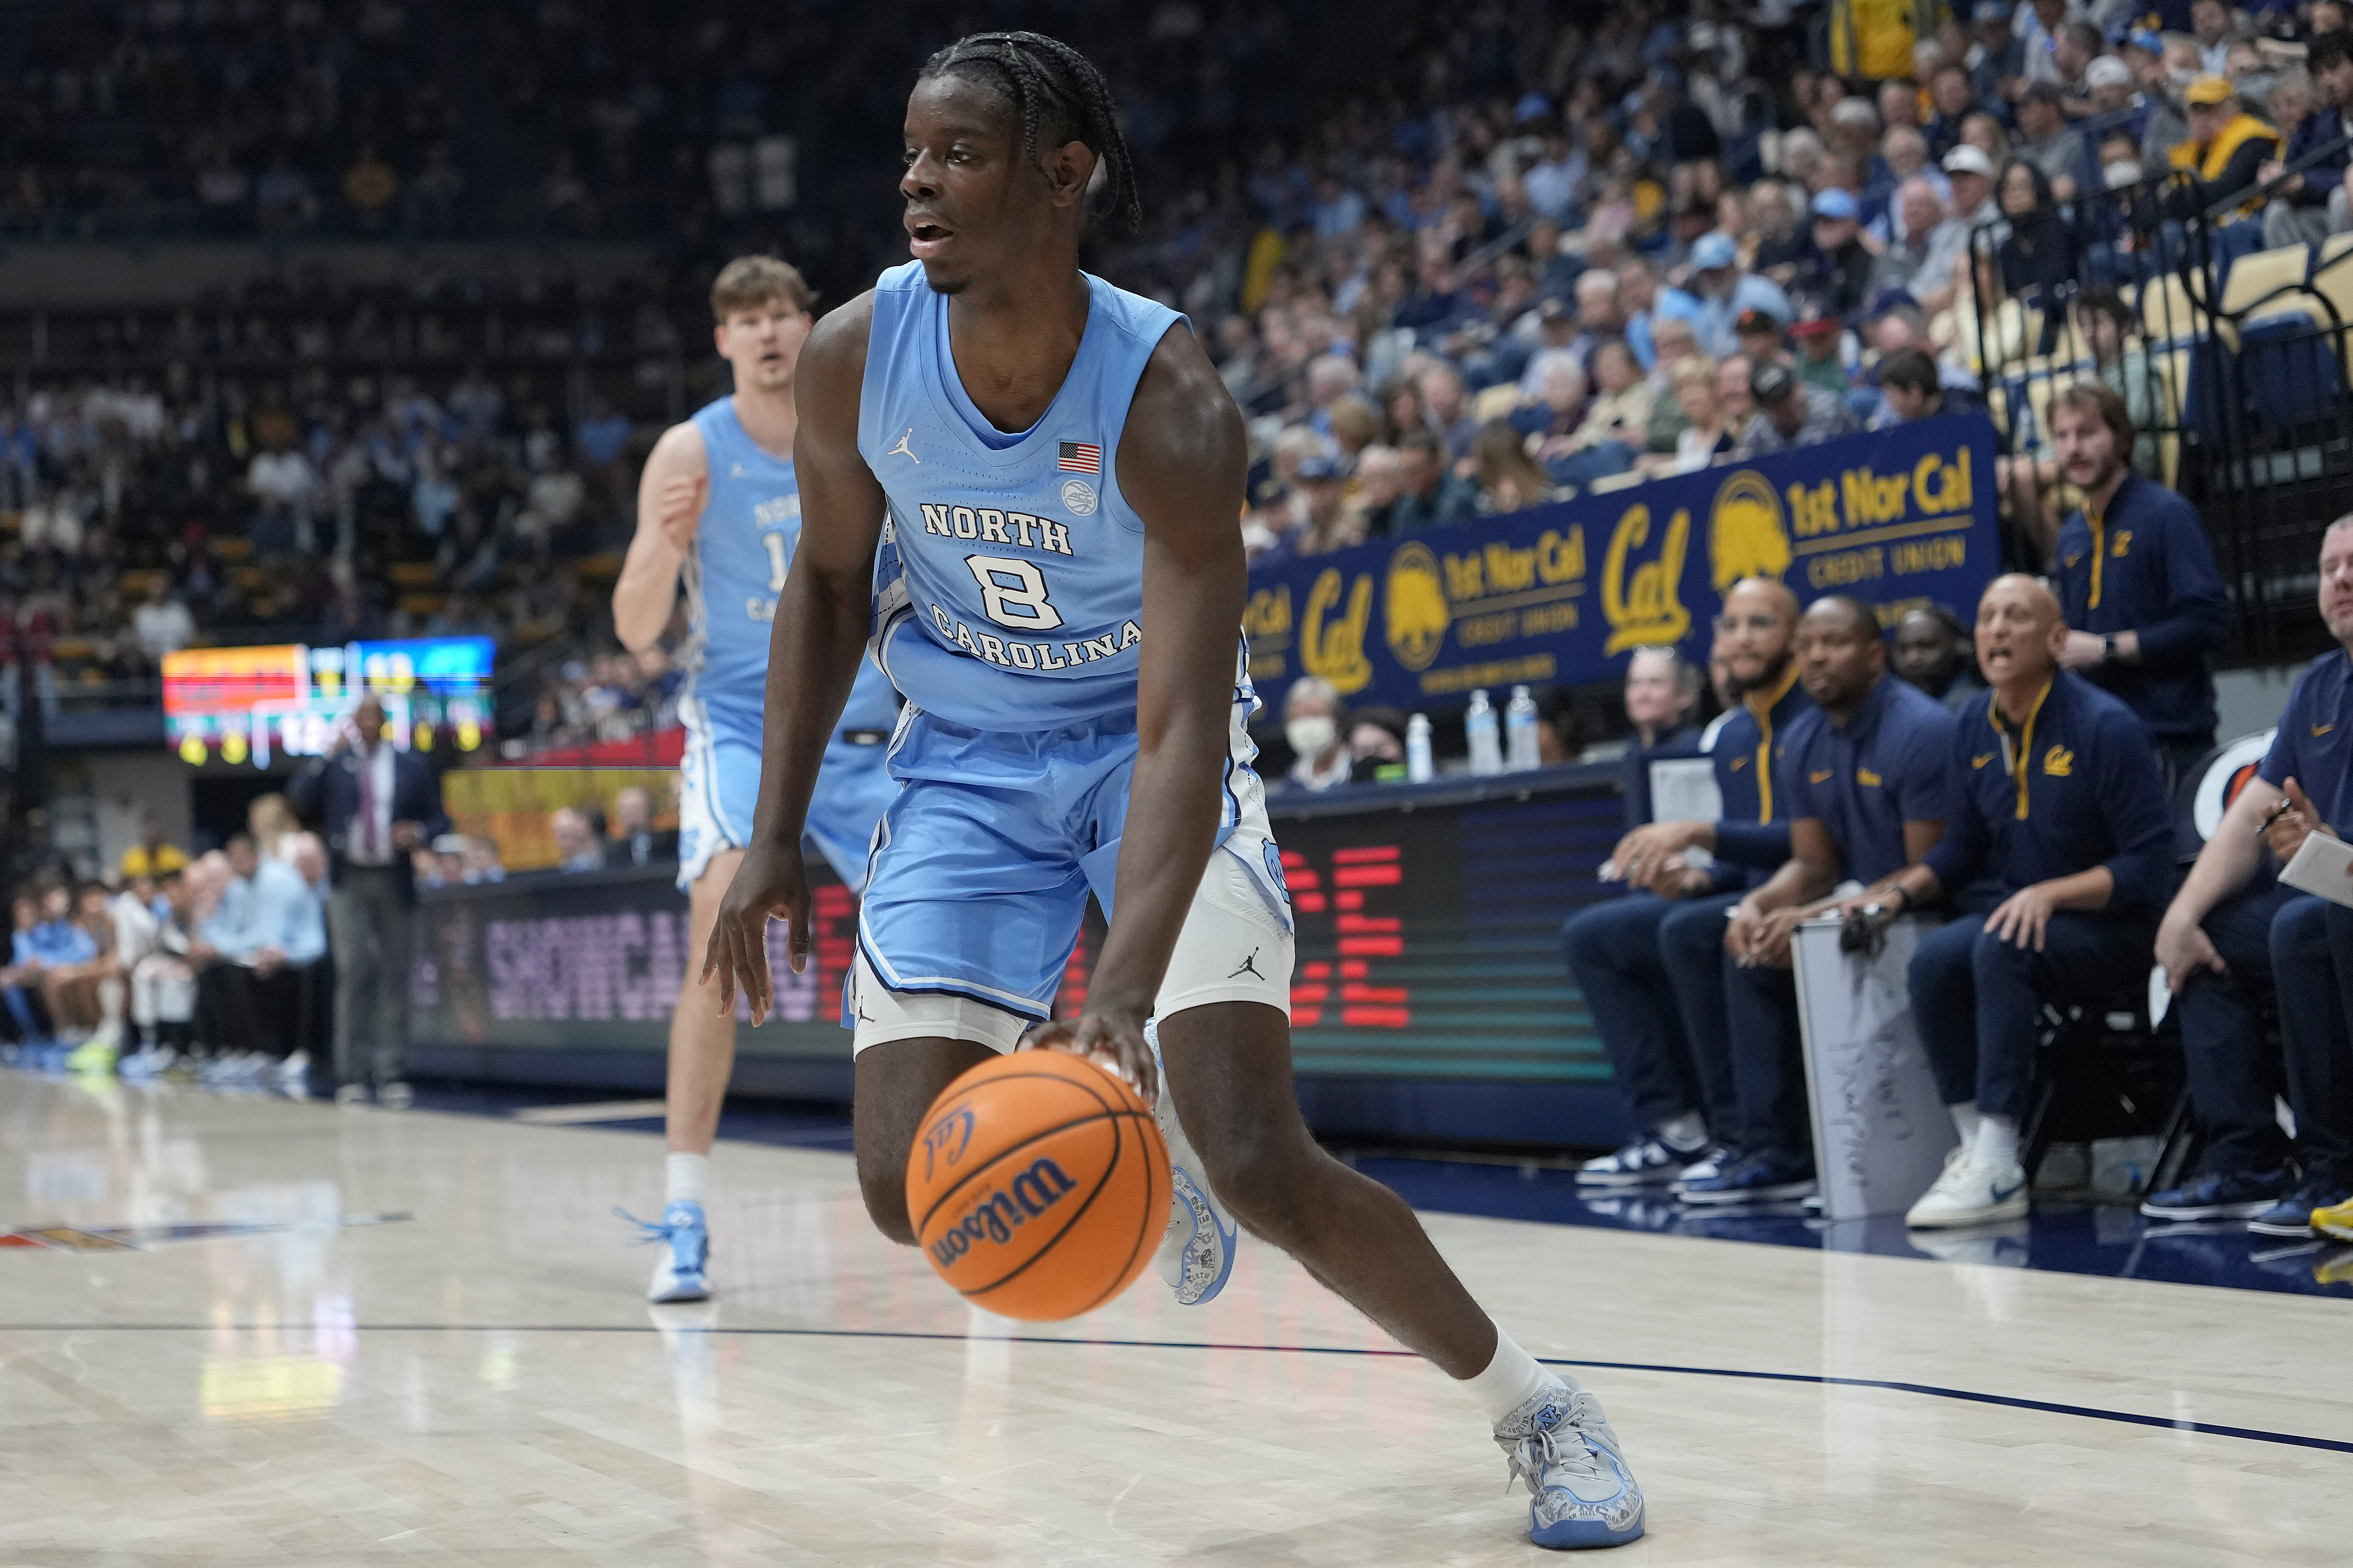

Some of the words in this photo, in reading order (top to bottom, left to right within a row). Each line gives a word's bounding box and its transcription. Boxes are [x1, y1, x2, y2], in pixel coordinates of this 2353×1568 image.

[1787, 479, 1838, 536] 1st
[1842, 466, 1910, 528] Nor
[1913, 445, 1972, 514] Cal
[920, 503, 1074, 556] NORTH
[1537, 524, 1585, 586] Cal
[964, 554, 1065, 630] 8
[1601, 503, 1691, 658] Cal
[931, 603, 1142, 670] CAROLINA
[1301, 568, 1372, 694] Cal
[924, 1101, 975, 1183] Cal
[929, 1157, 1078, 1269] Wilson
[1198, 1215, 1211, 1224] TAR
[1503, 1415, 1529, 1433] CAROLINA
